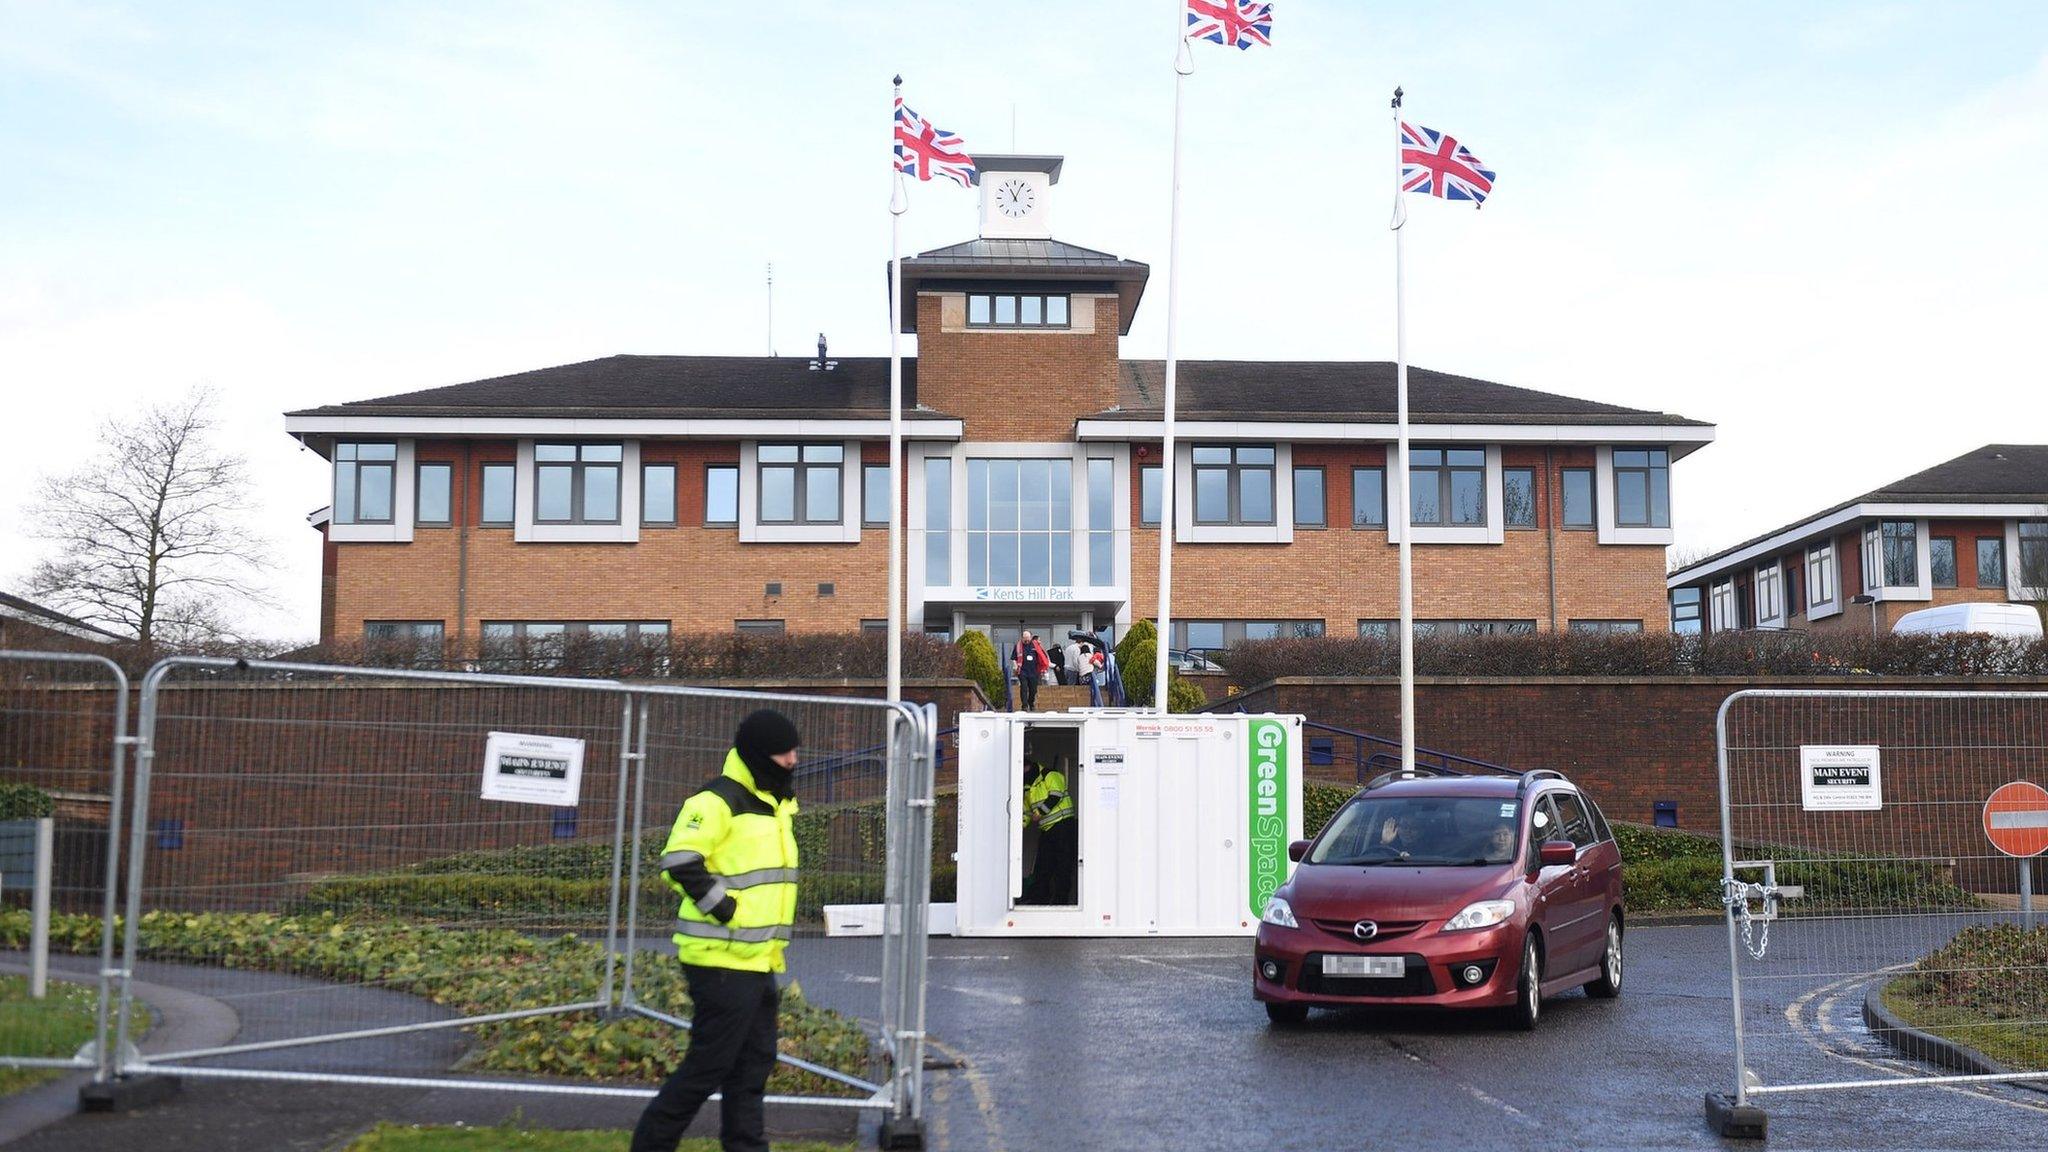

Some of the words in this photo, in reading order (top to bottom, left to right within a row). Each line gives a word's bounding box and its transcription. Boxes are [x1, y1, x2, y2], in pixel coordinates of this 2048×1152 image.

[993, 588, 1024, 600] Kents
[1028, 588, 1046, 600] Hill
[1050, 588, 1073, 600] Park
[1814, 768, 1837, 777] MAIN
[1839, 768, 1868, 777] EVENT
